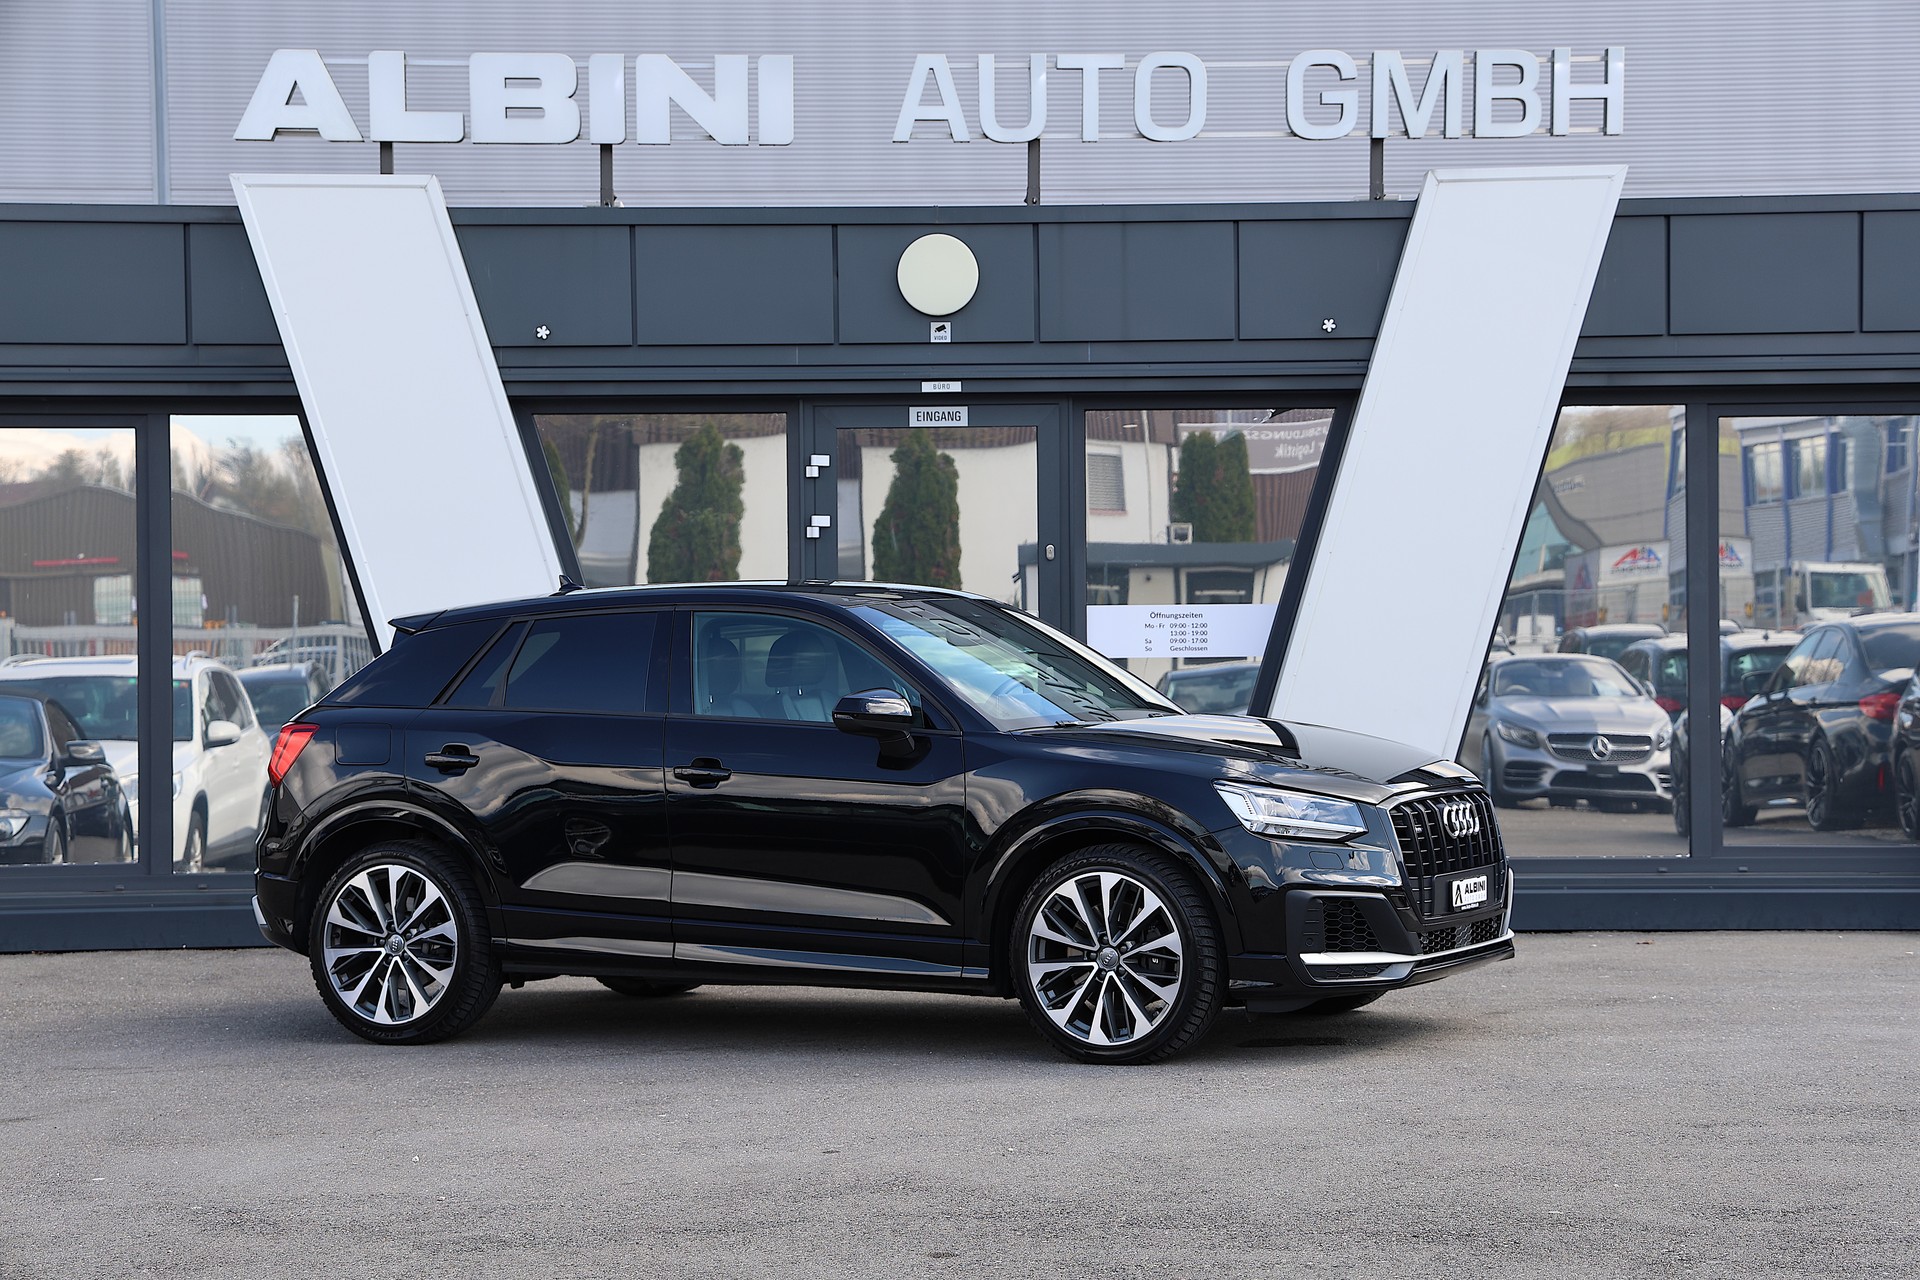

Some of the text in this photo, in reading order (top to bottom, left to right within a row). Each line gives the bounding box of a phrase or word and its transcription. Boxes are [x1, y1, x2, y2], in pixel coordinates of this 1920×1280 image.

[233, 46, 1625, 145] ALBINI AUTO GMBH
[932, 382, 951, 390] BÜRO
[916, 411, 962, 422] EINGANG
[1150, 612, 1203, 620] Öffnungszeiten
[1464, 880, 1486, 895] ALBINI
